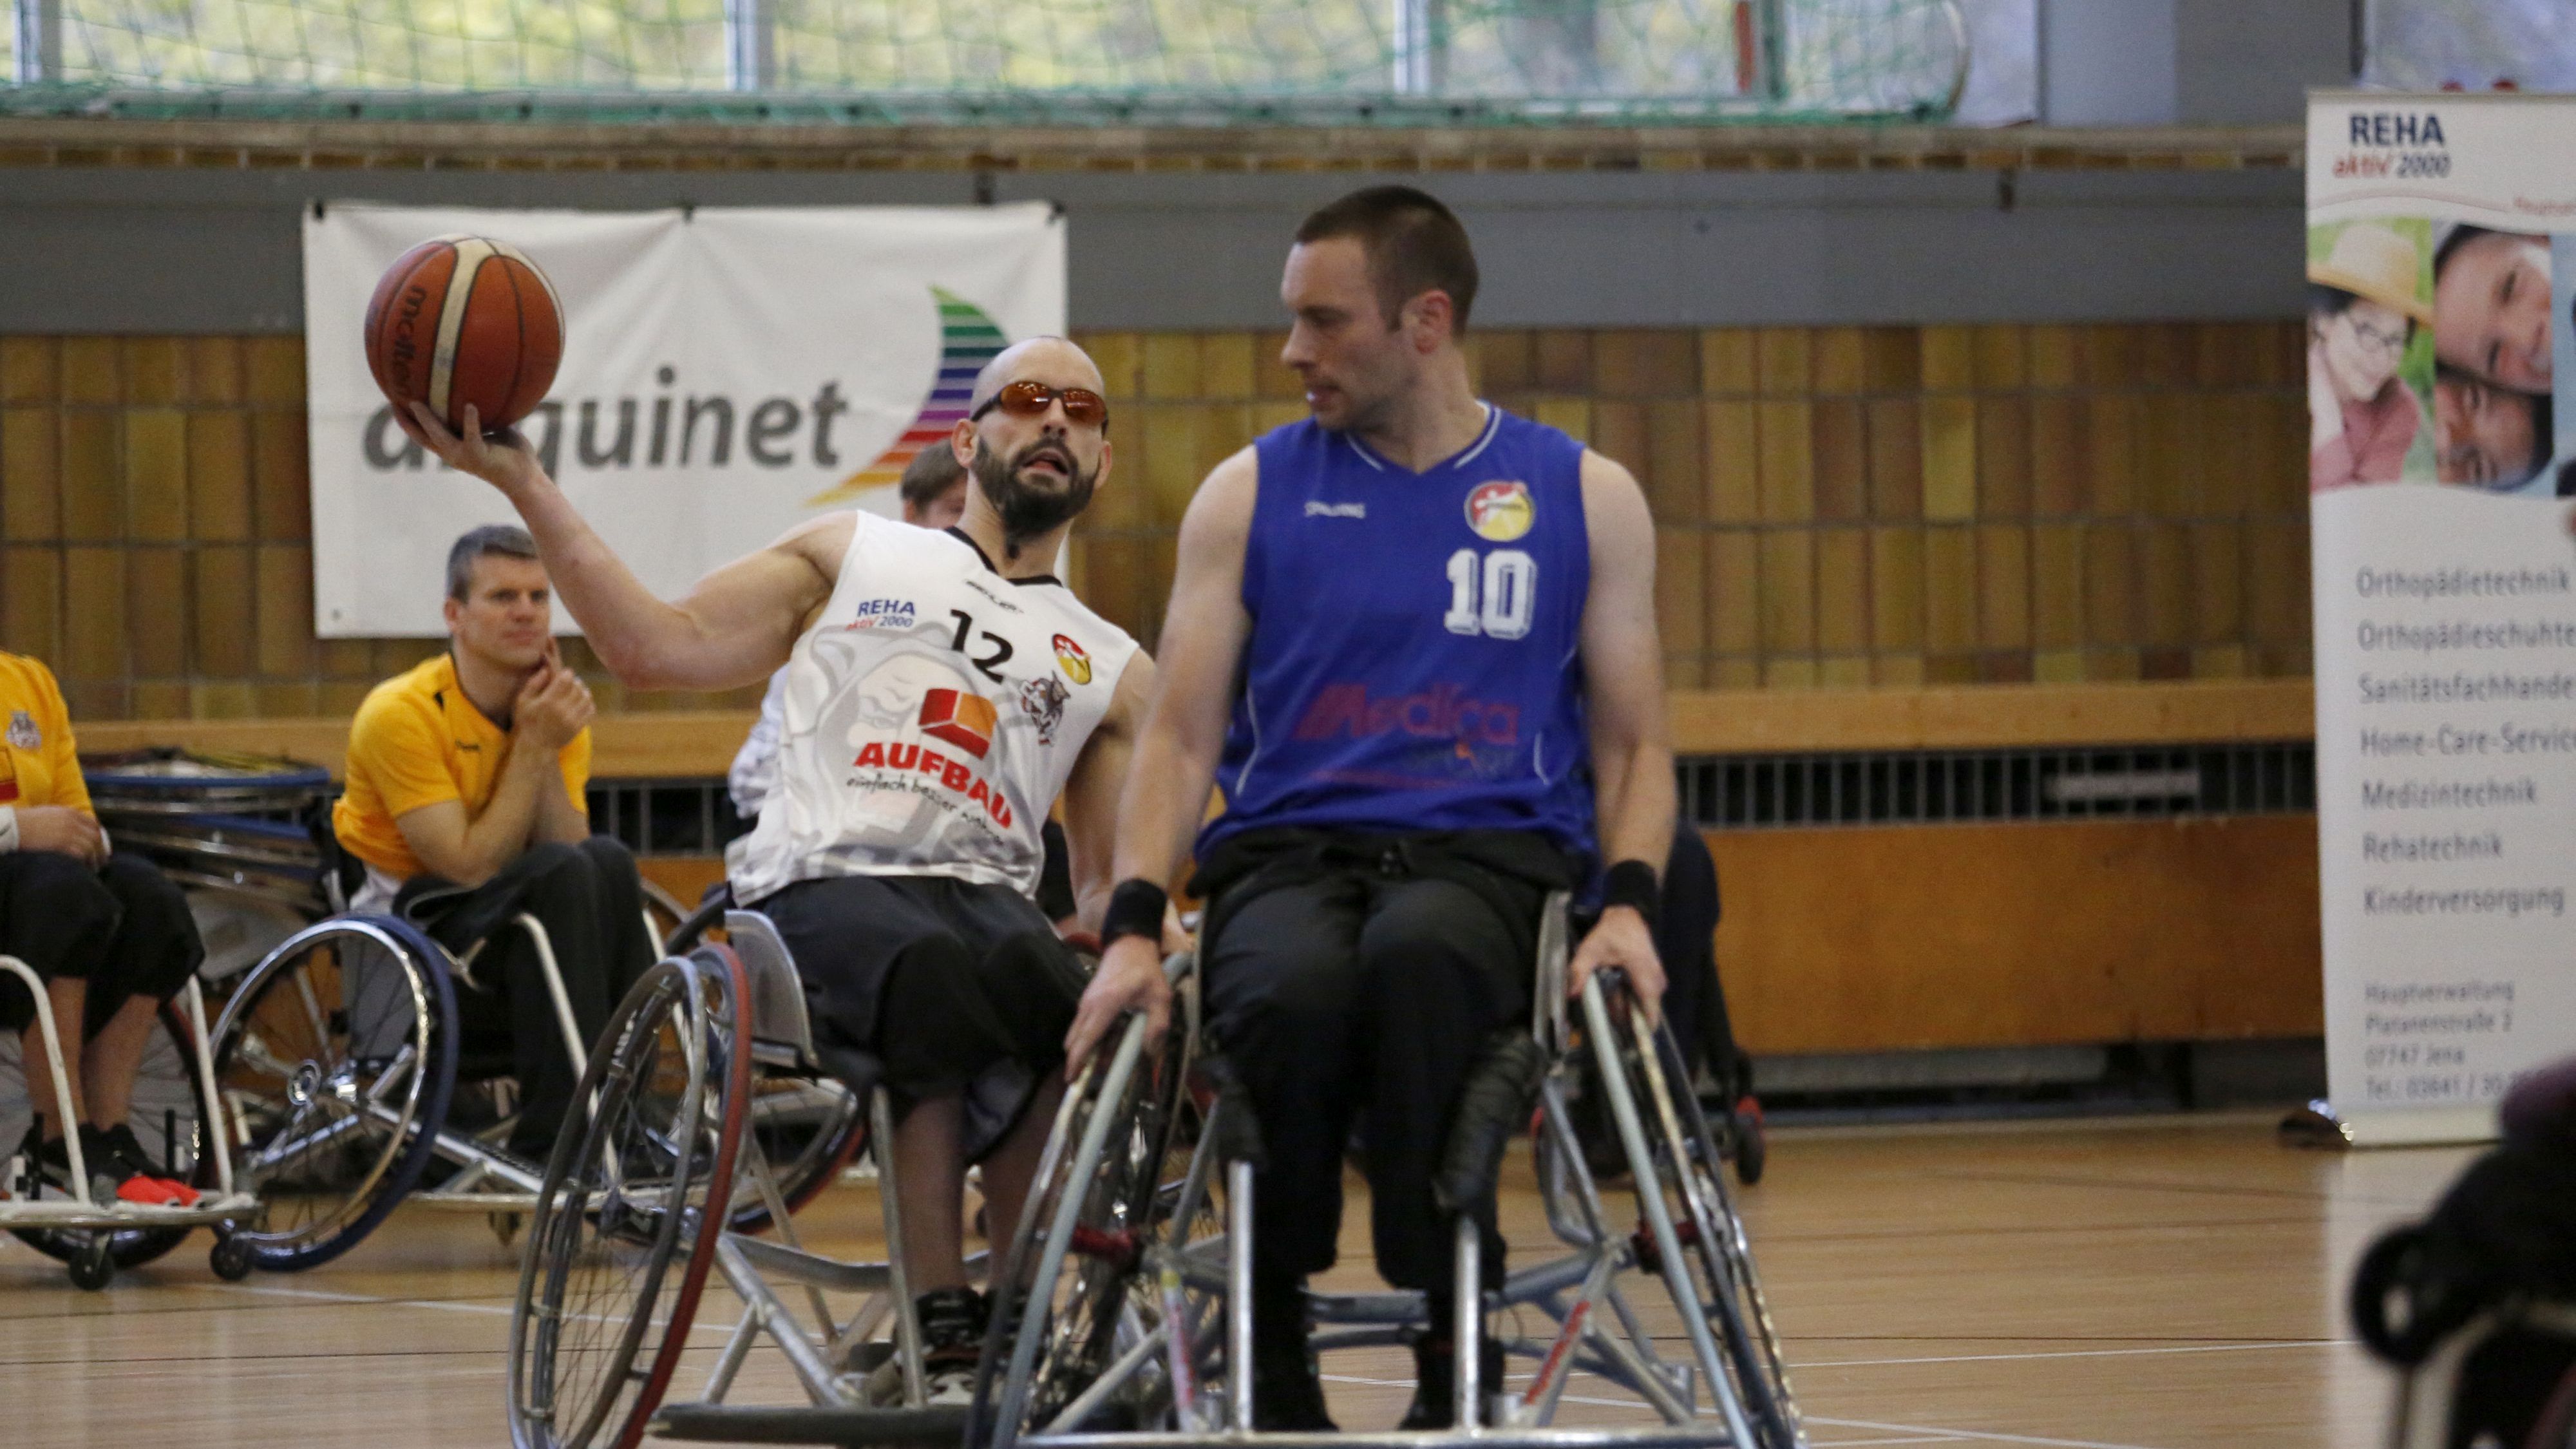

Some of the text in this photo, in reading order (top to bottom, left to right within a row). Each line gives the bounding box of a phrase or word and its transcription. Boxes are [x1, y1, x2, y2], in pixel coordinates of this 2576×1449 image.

[2349, 111, 2445, 146] REHA
[2396, 151, 2452, 178] 2000
[1444, 548, 1537, 640] 10
[2356, 565, 2570, 602] Orthopädietechnik
[857, 599, 916, 617] REHA
[878, 616, 913, 628] 2000
[950, 609, 1014, 684] 12
[853, 743, 1012, 829] AUFBAU
[2362, 775, 2536, 809] Medizintechnik
[2363, 831, 2503, 864] Rehatechnik
[2363, 886, 2564, 919] Kinderversorgung
